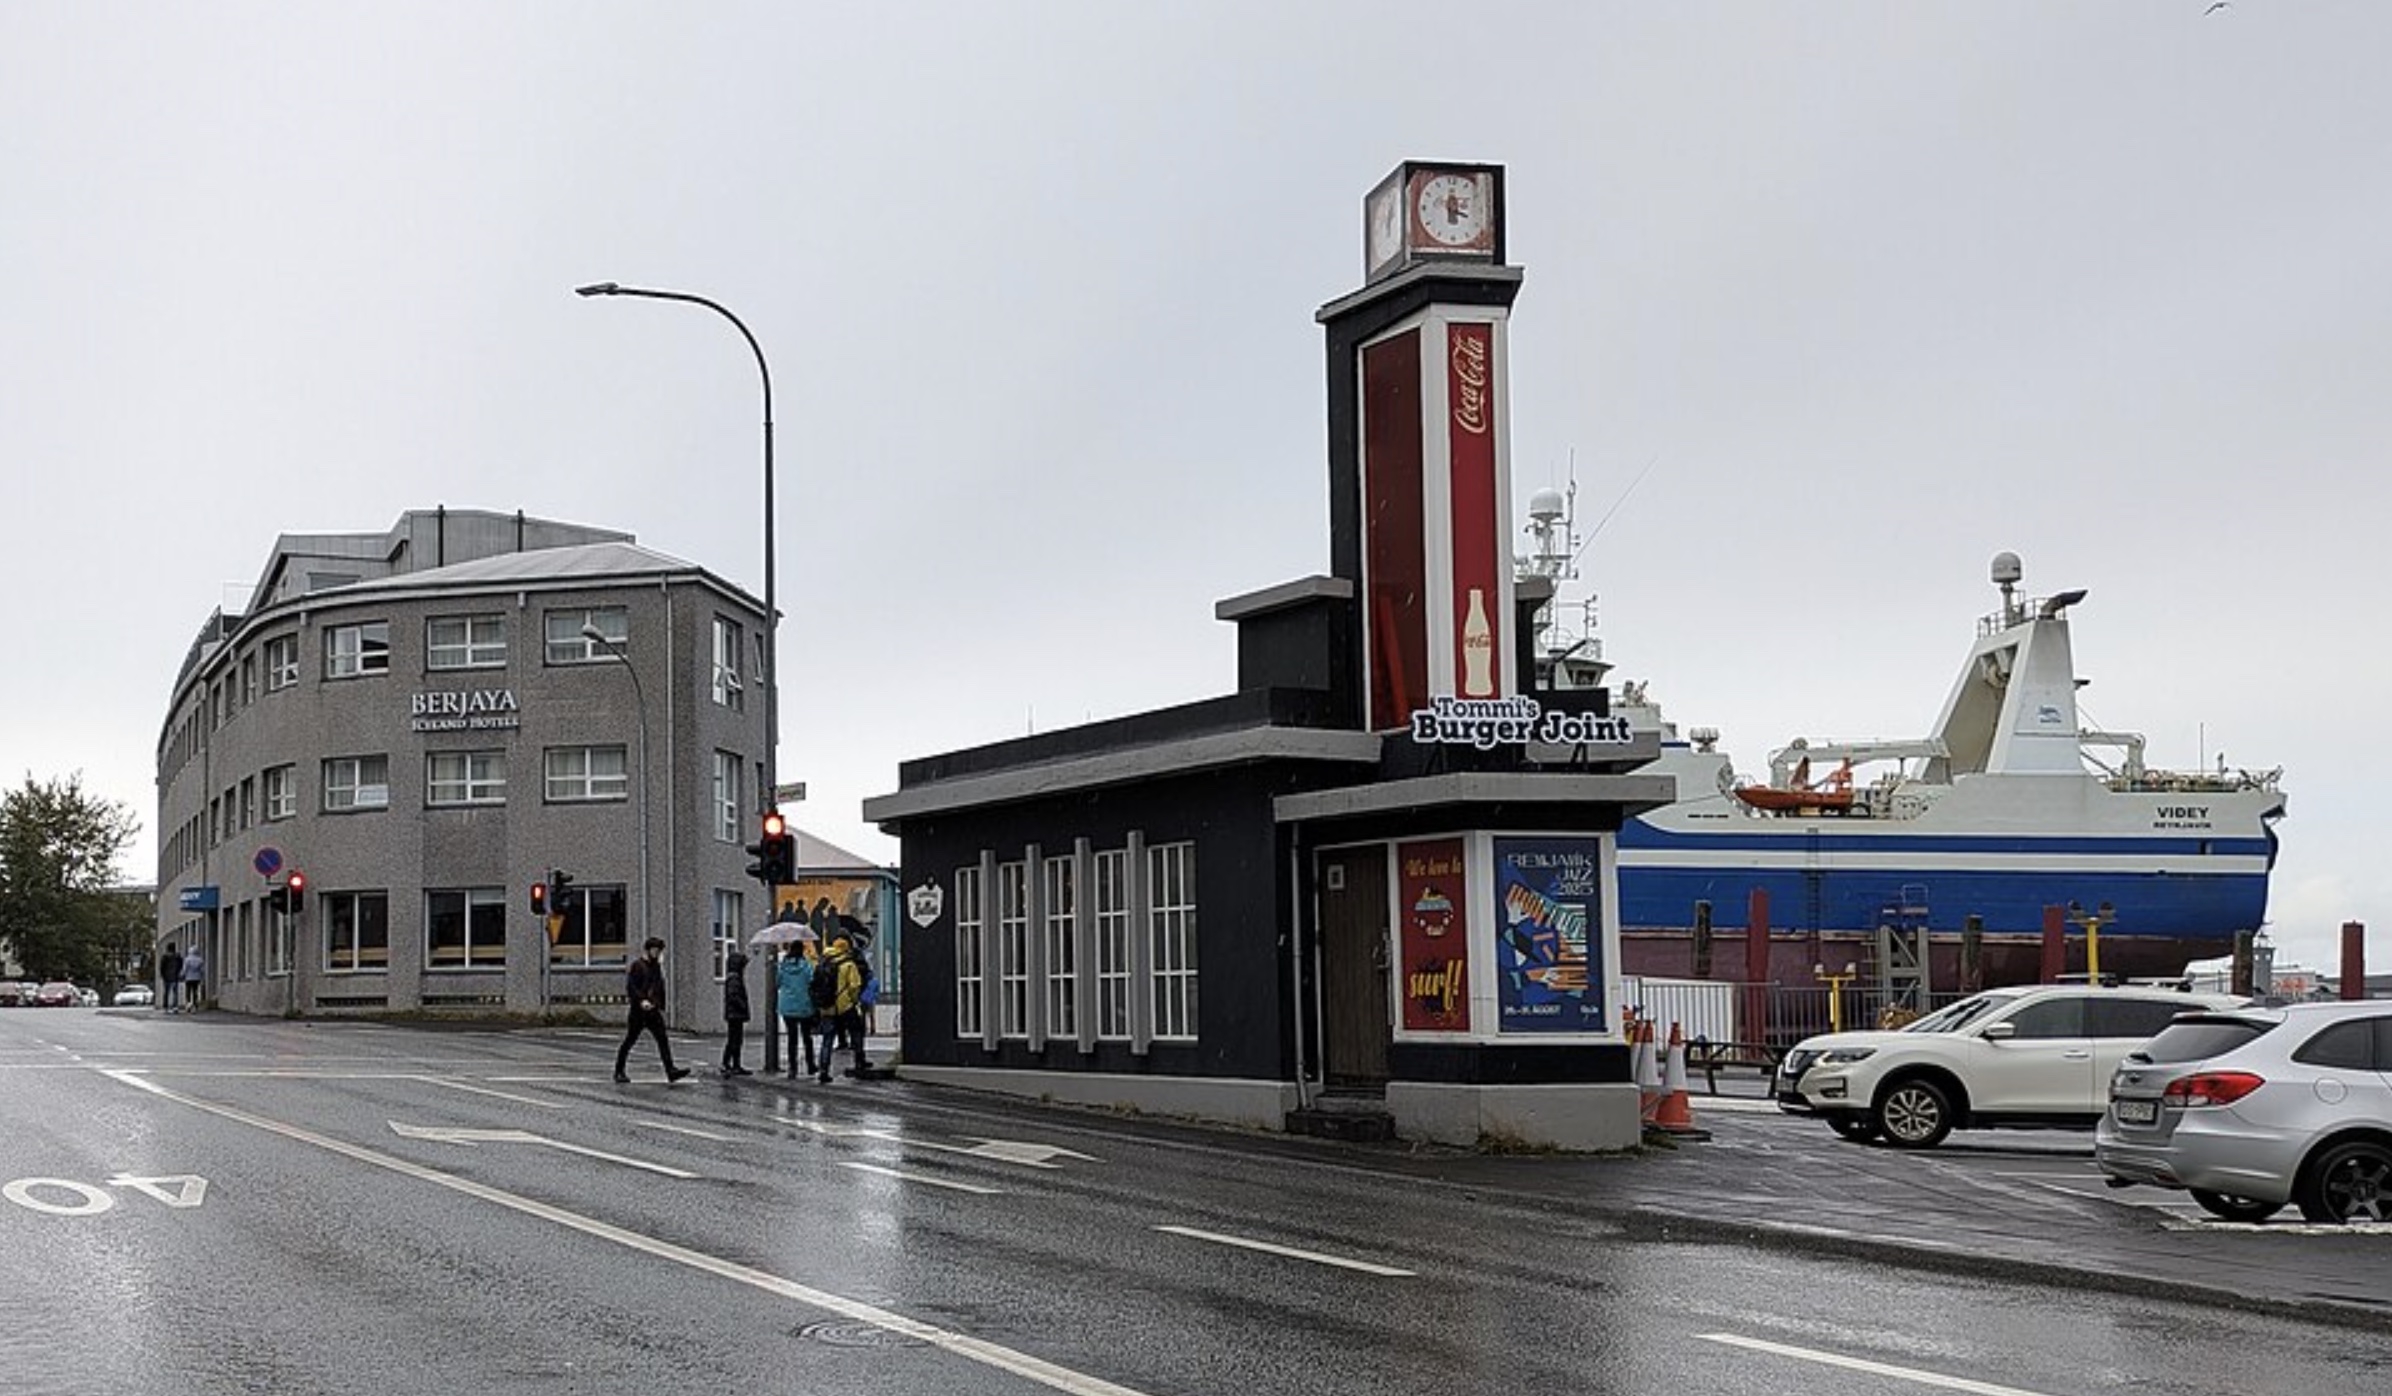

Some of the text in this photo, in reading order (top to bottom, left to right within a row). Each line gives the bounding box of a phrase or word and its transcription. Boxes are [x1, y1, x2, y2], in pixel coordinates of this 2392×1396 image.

[411, 689, 518, 718] BERJAYA
[1436, 698, 1538, 718] Tommi's
[1416, 713, 1631, 746] Burger Joint
[2, 1171, 209, 1216] 40
